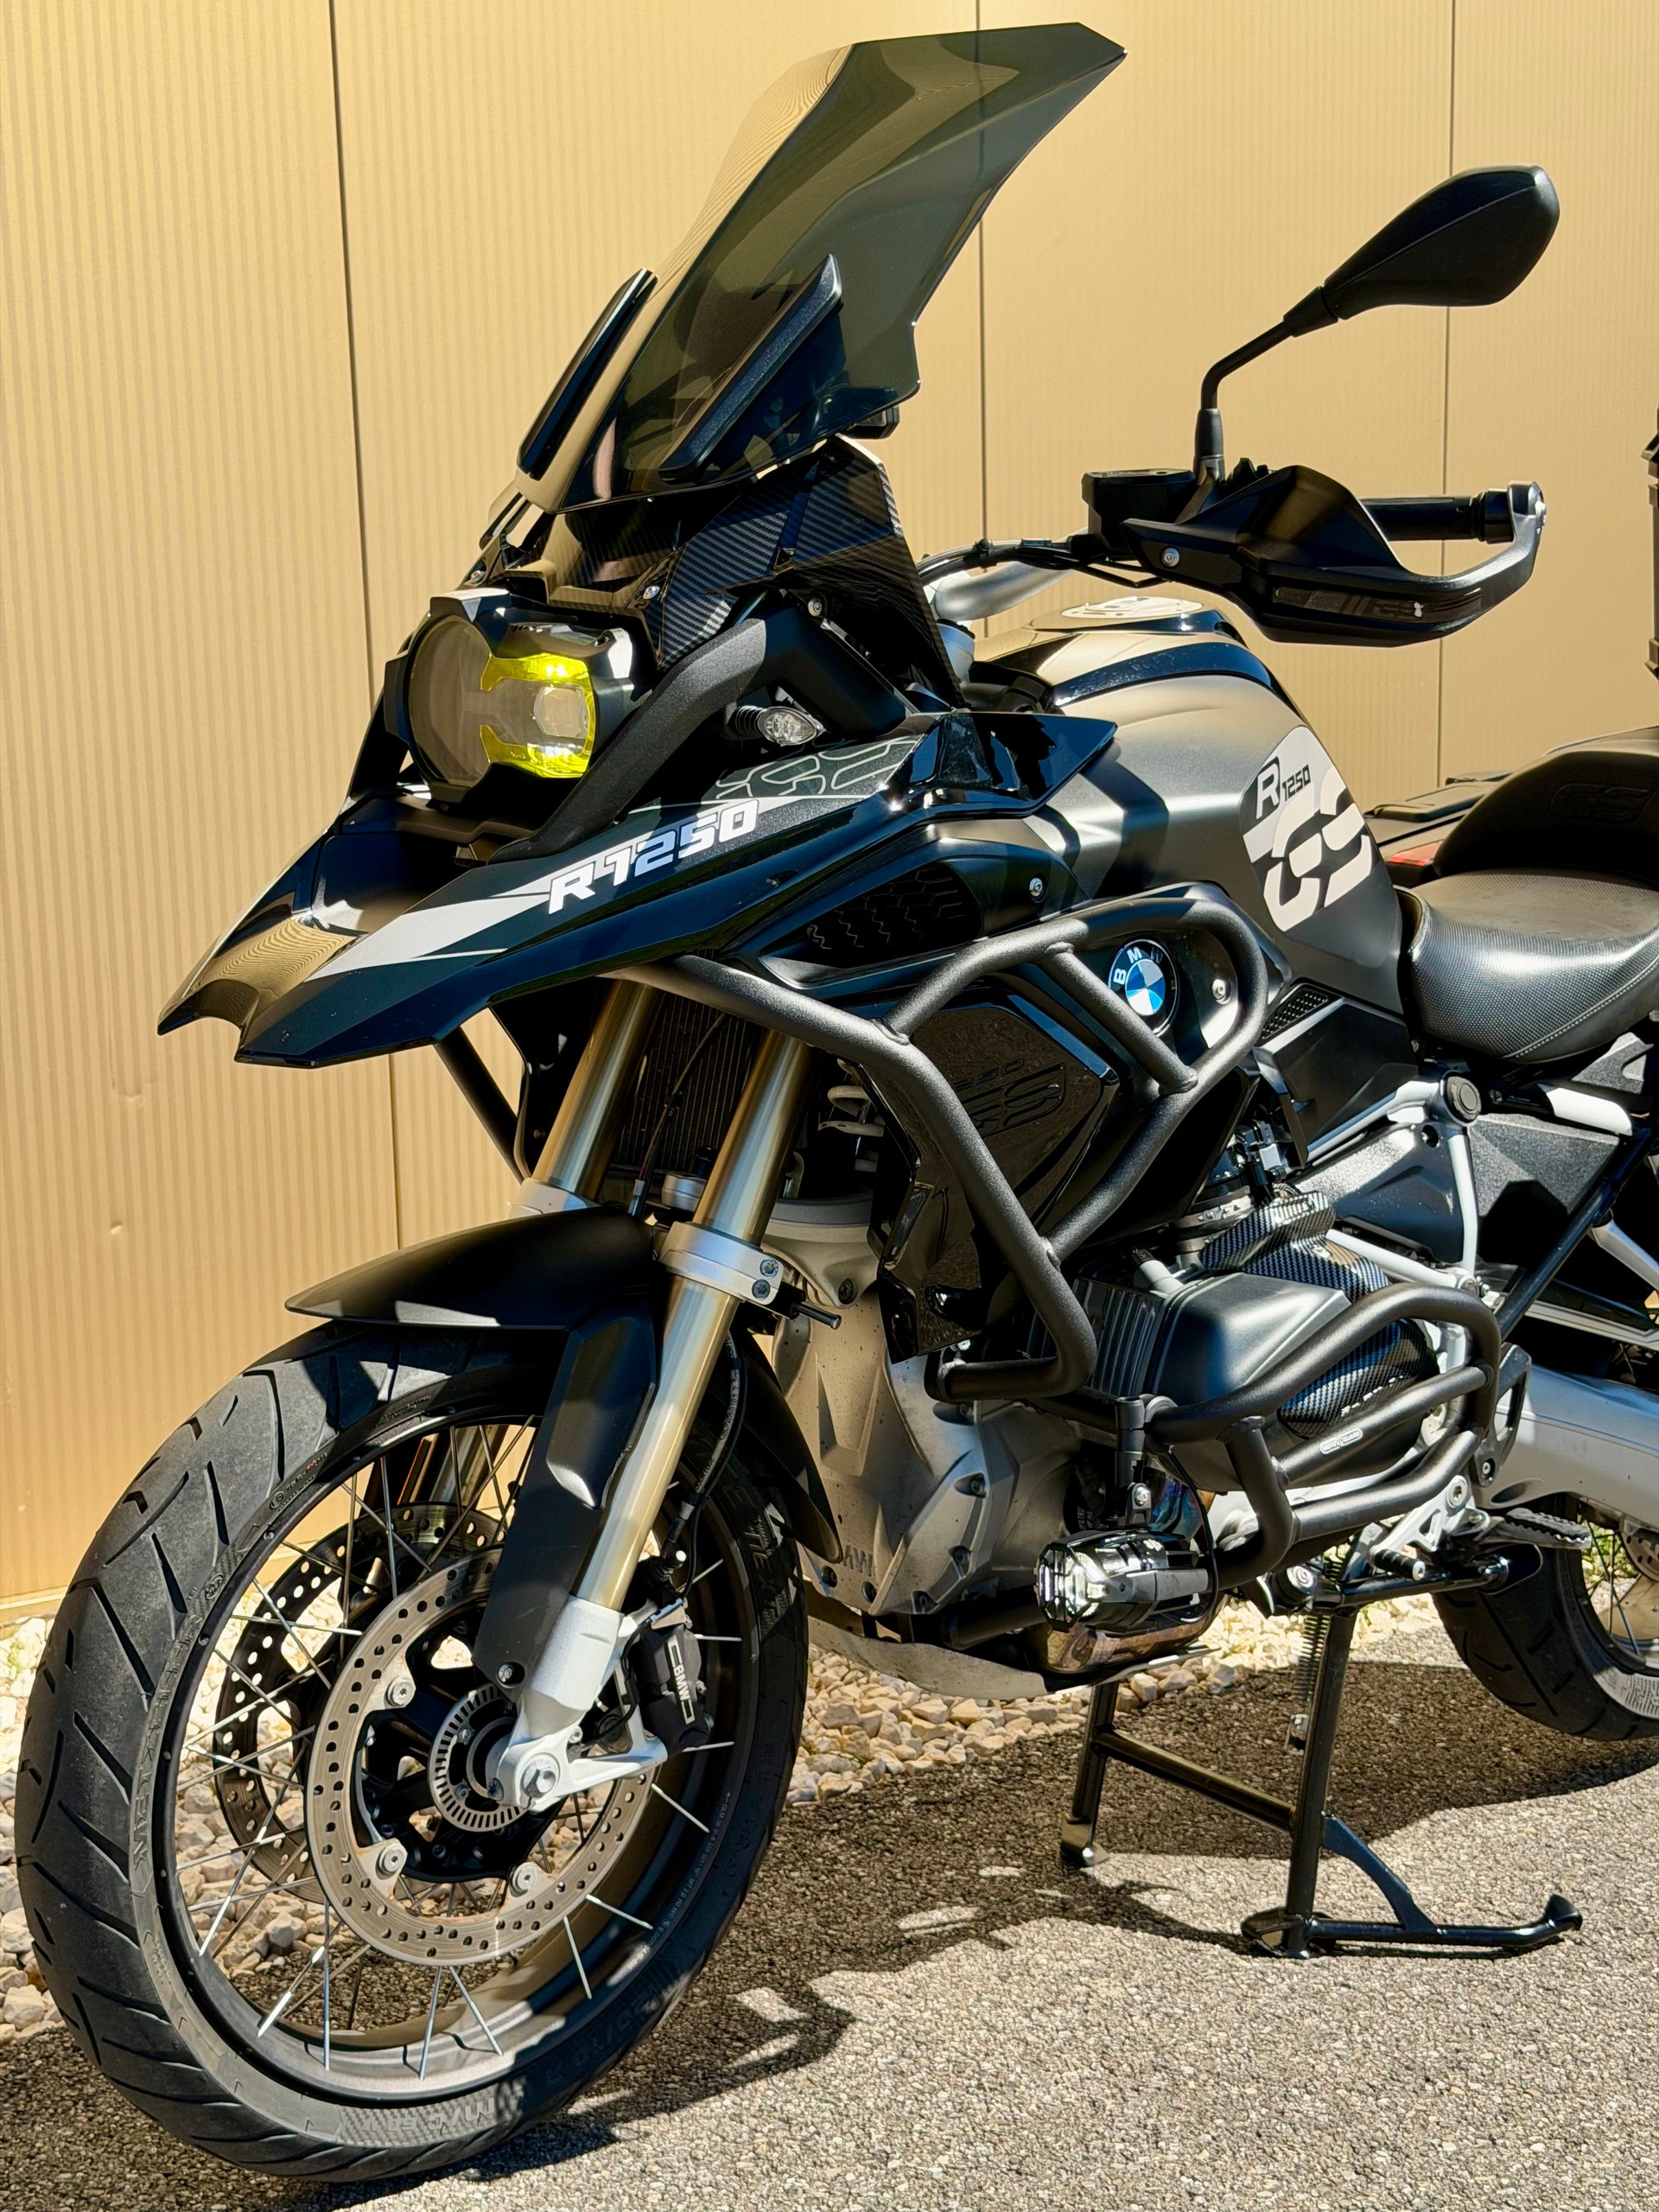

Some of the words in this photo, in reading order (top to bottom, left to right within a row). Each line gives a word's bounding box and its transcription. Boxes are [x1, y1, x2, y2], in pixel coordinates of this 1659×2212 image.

[1263, 766, 1372, 932] GS
[1112, 946, 1164, 985] BMW
[674, 1664, 691, 1701] BMW
